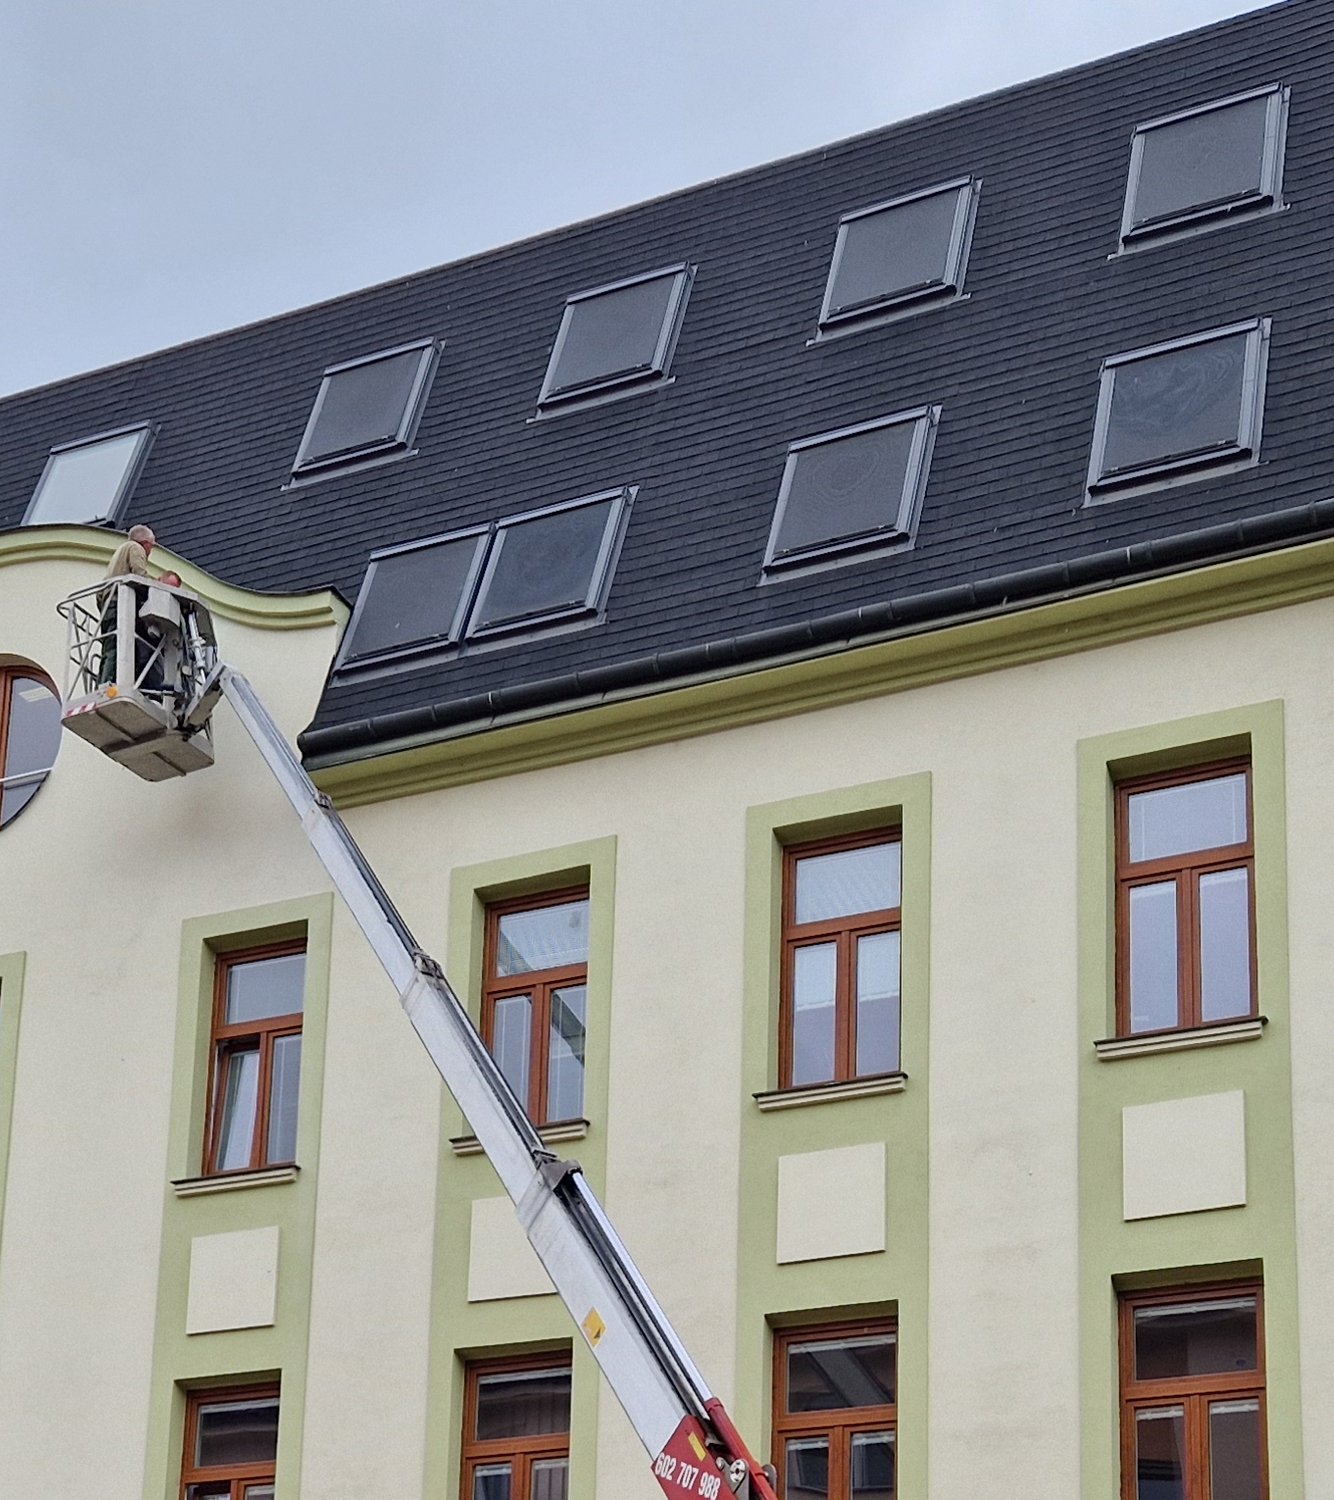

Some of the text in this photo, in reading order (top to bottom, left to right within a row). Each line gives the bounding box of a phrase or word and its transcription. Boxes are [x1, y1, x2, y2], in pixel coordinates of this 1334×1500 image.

[654, 1452, 721, 1500] 602 707 988
